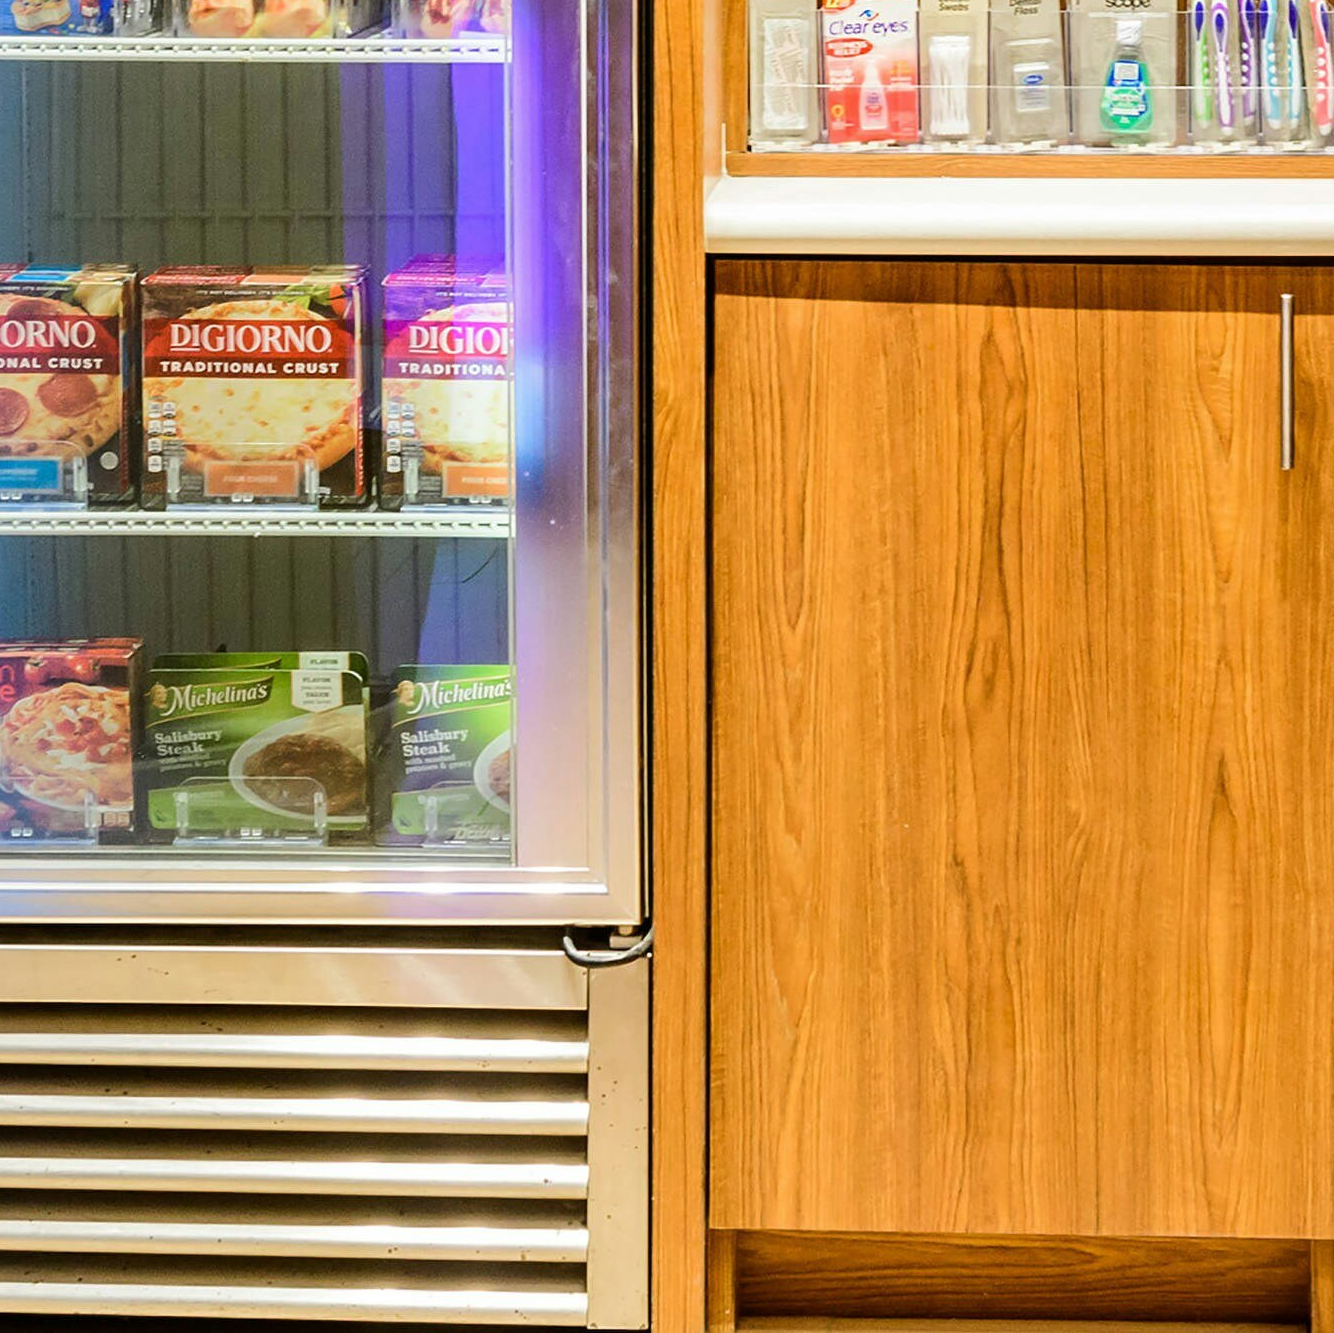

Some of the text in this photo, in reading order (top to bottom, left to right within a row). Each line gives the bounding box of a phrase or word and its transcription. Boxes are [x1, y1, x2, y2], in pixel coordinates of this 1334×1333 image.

[939, 3, 970, 11] Swabs
[1013, 6, 1039, 16] Floss
[829, 20, 908, 37] Clear eyes
[48, 357, 104, 369] CRUST
[160, 361, 340, 375] TRADITIONAL CRUST
[398, 362, 506, 376] TRADITIONA
[160, 683, 268, 716] Michelina's
[154, 729, 223, 746] Salisbury
[400, 728, 469, 744] Salisbury
[157, 743, 204, 757] Steak
[403, 742, 451, 757] Steak
